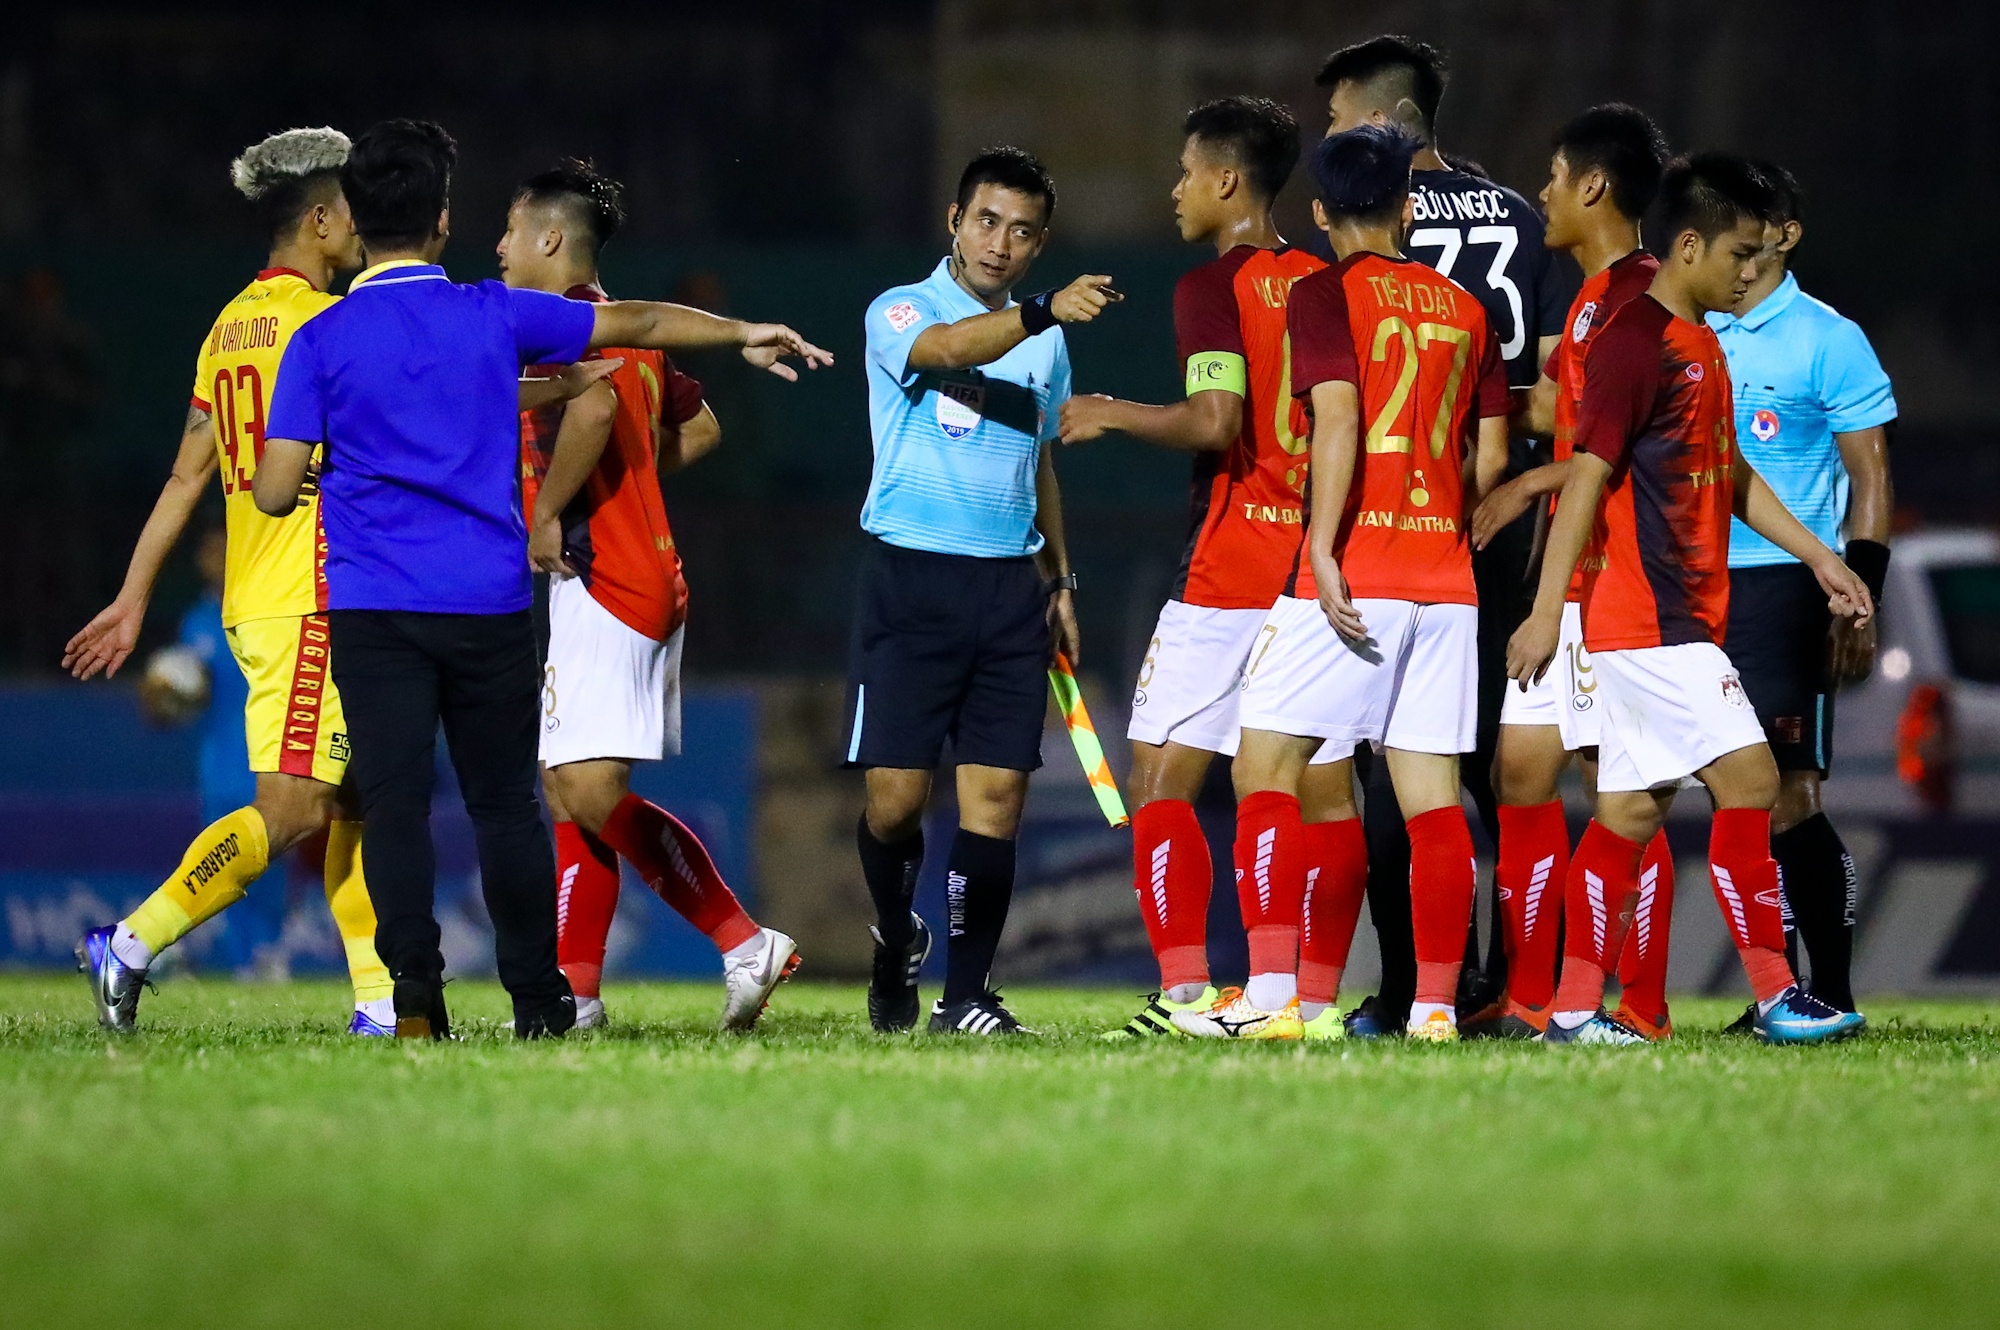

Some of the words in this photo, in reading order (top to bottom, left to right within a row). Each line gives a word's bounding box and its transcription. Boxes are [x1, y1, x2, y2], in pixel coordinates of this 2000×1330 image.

[1450, 189, 1510, 224] NGỌC
[243, 316, 279, 350] LONG
[943, 384, 979, 403] FIFA
[1366, 316, 1470, 460] 27
[214, 364, 266, 496] 93
[946, 426, 965, 435] 2019
[287, 615, 328, 751] JOGARBOLA
[1566, 641, 1598, 696] 19
[183, 833, 240, 896] JOGARBOLA
[1841, 853, 1857, 926] JOGARBOLA
[948, 870, 967, 937] JOGARBOLA
